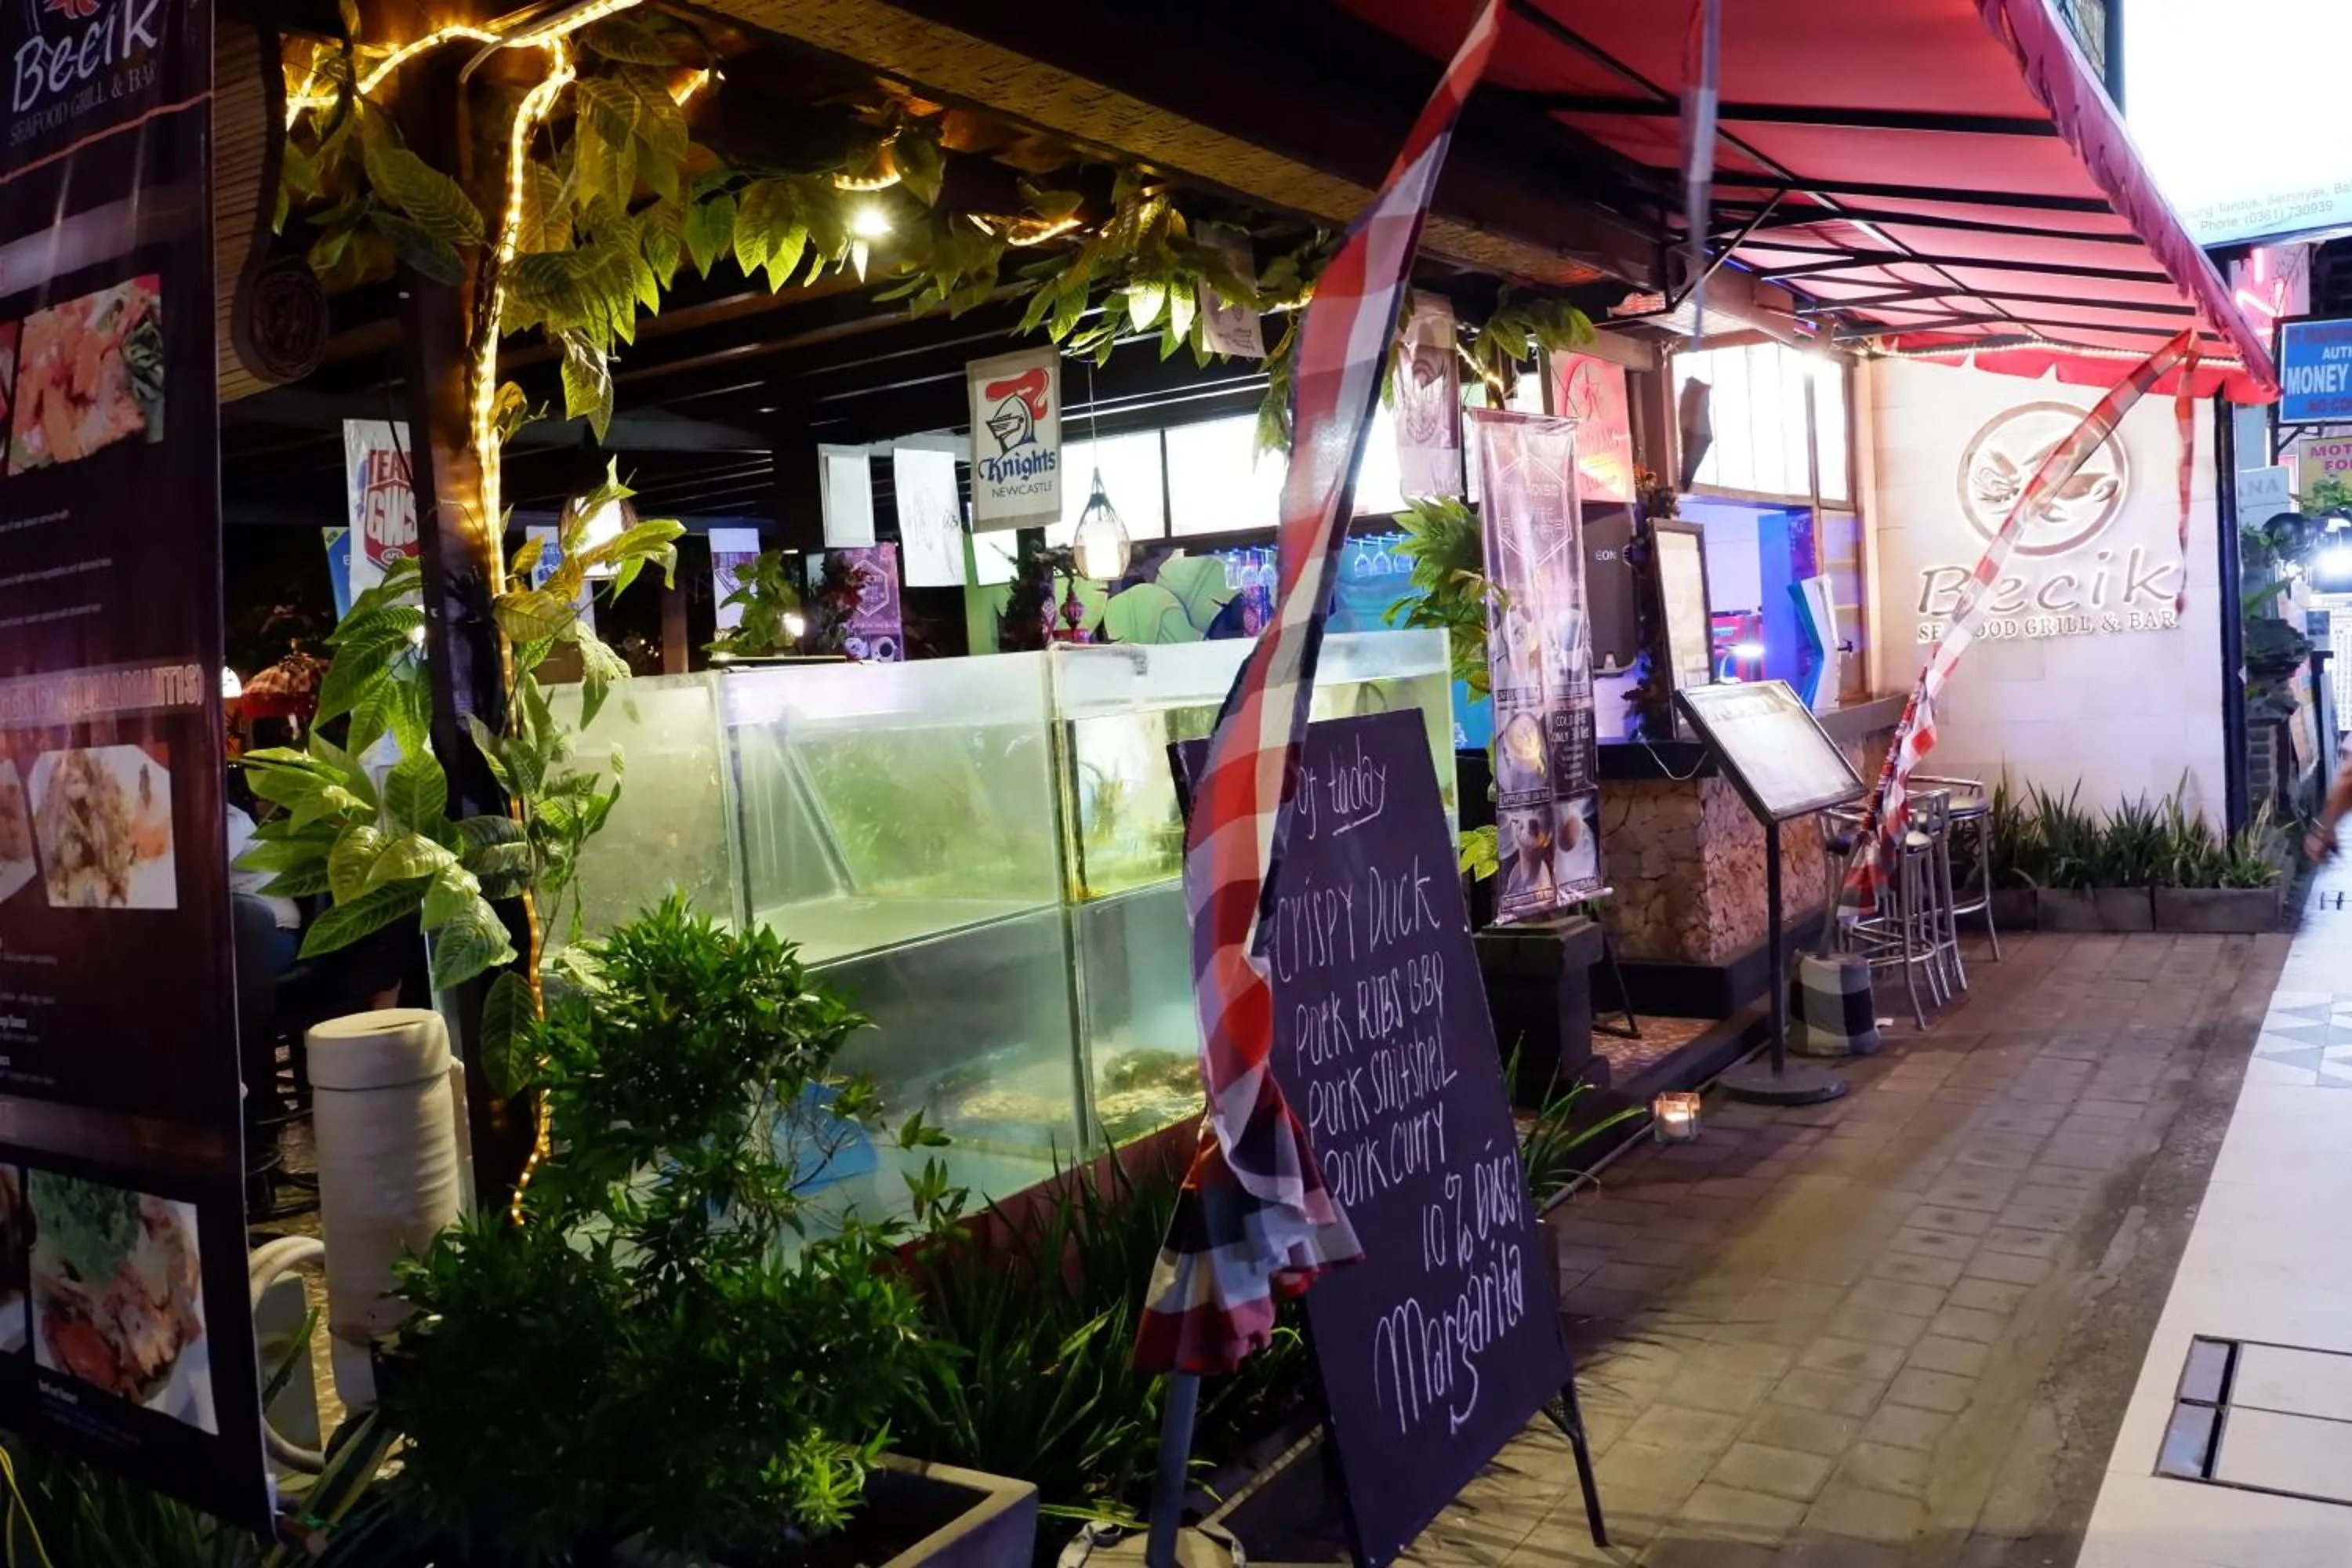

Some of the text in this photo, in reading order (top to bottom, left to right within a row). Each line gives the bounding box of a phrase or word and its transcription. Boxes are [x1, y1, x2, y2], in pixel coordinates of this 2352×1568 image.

[111, 74, 124, 99] &
[2286, 363, 2350, 397] MONEY
[978, 448, 1056, 485] Knights
[992, 481, 1052, 499] NEWCASTLE
[1918, 546, 2176, 618] Becik
[1918, 608, 2176, 641] SEOOD GRILL & BAR
[1374, 1240, 1525, 1436] Margarita
